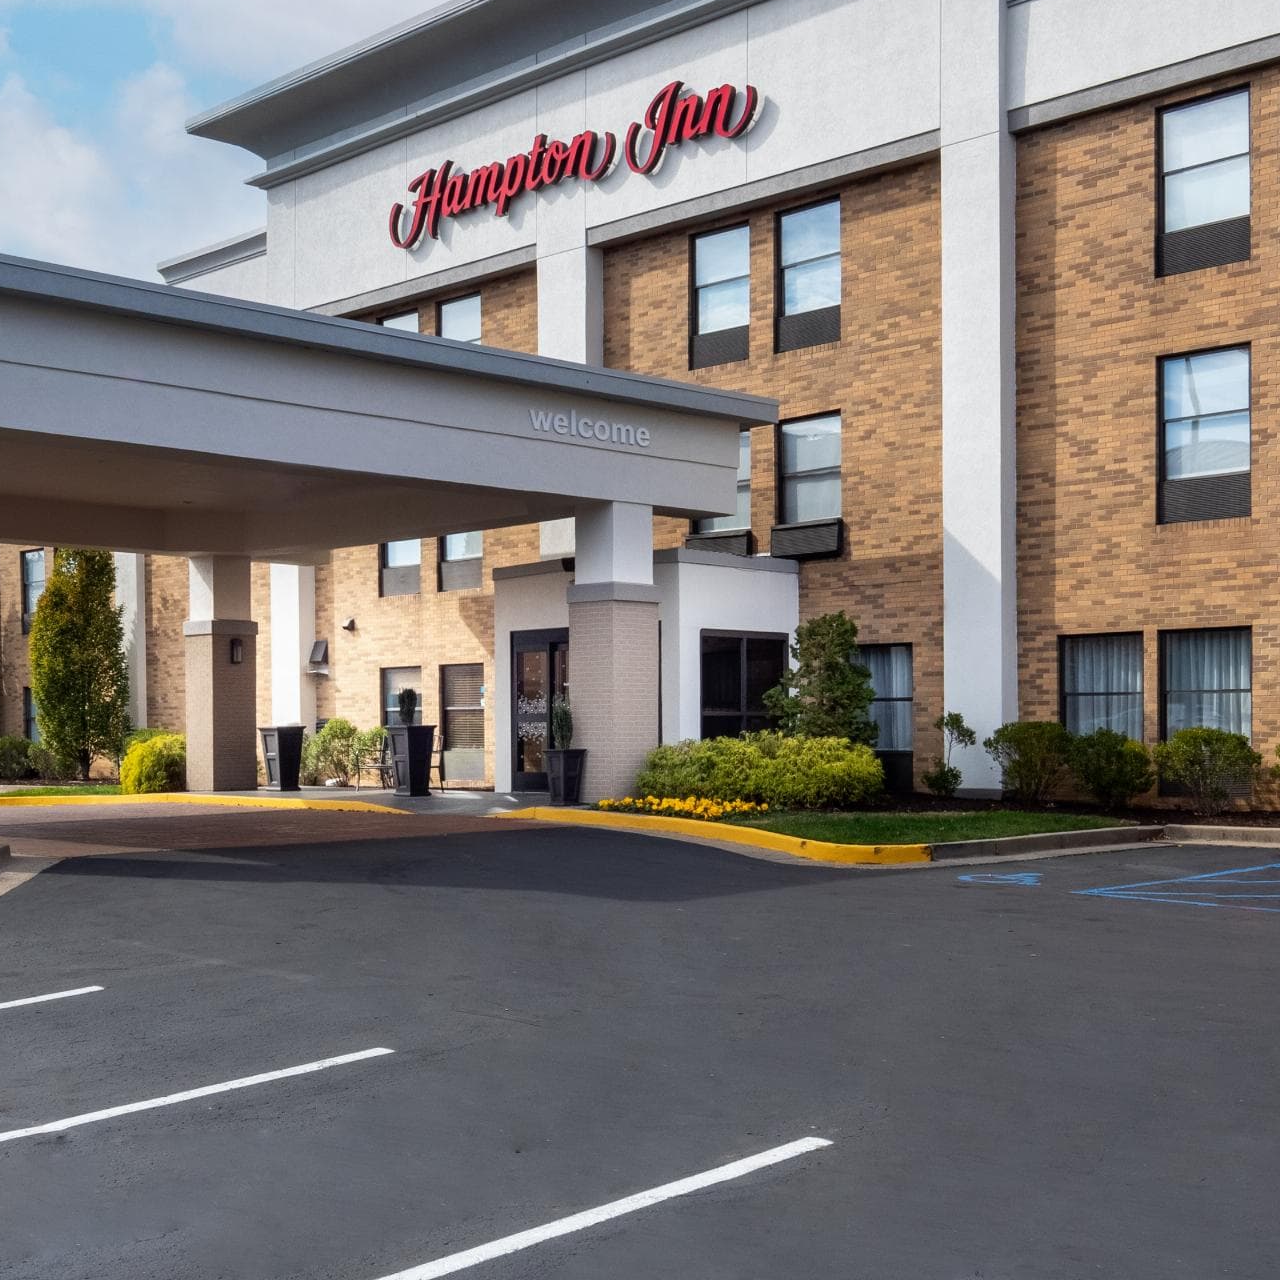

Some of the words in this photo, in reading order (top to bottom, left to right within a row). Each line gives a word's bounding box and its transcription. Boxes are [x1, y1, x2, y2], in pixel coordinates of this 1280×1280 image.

[389, 130, 616, 250] Hampton
[625, 80, 762, 175] Inn
[528, 408, 651, 447] welcome
